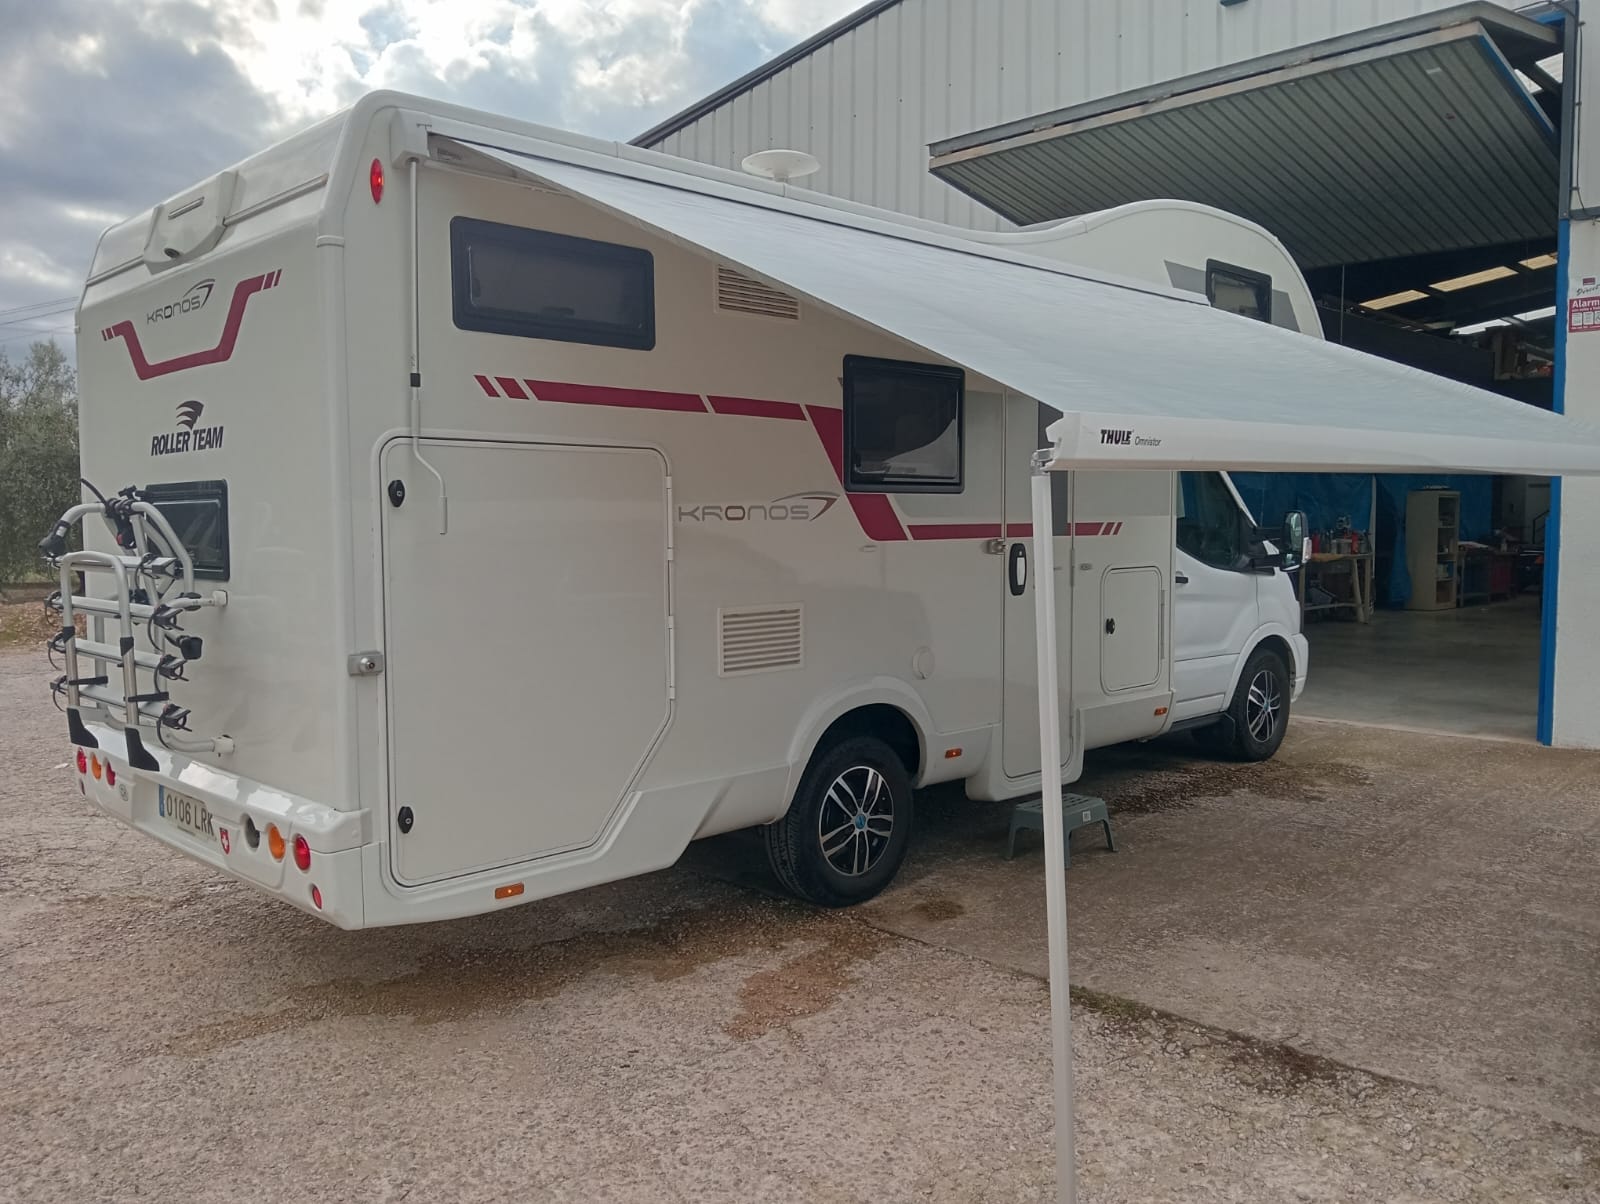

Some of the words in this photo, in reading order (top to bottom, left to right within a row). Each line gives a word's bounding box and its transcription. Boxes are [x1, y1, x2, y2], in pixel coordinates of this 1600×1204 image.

[146, 295, 201, 325] KRONOS
[151, 431, 191, 457] ROLLER
[193, 426, 224, 451] TEAM
[1100, 429, 1132, 445] THULE
[1135, 436, 1161, 446] Omnistor
[166, 794, 191, 825] 0106
[194, 805, 215, 836] LRK
